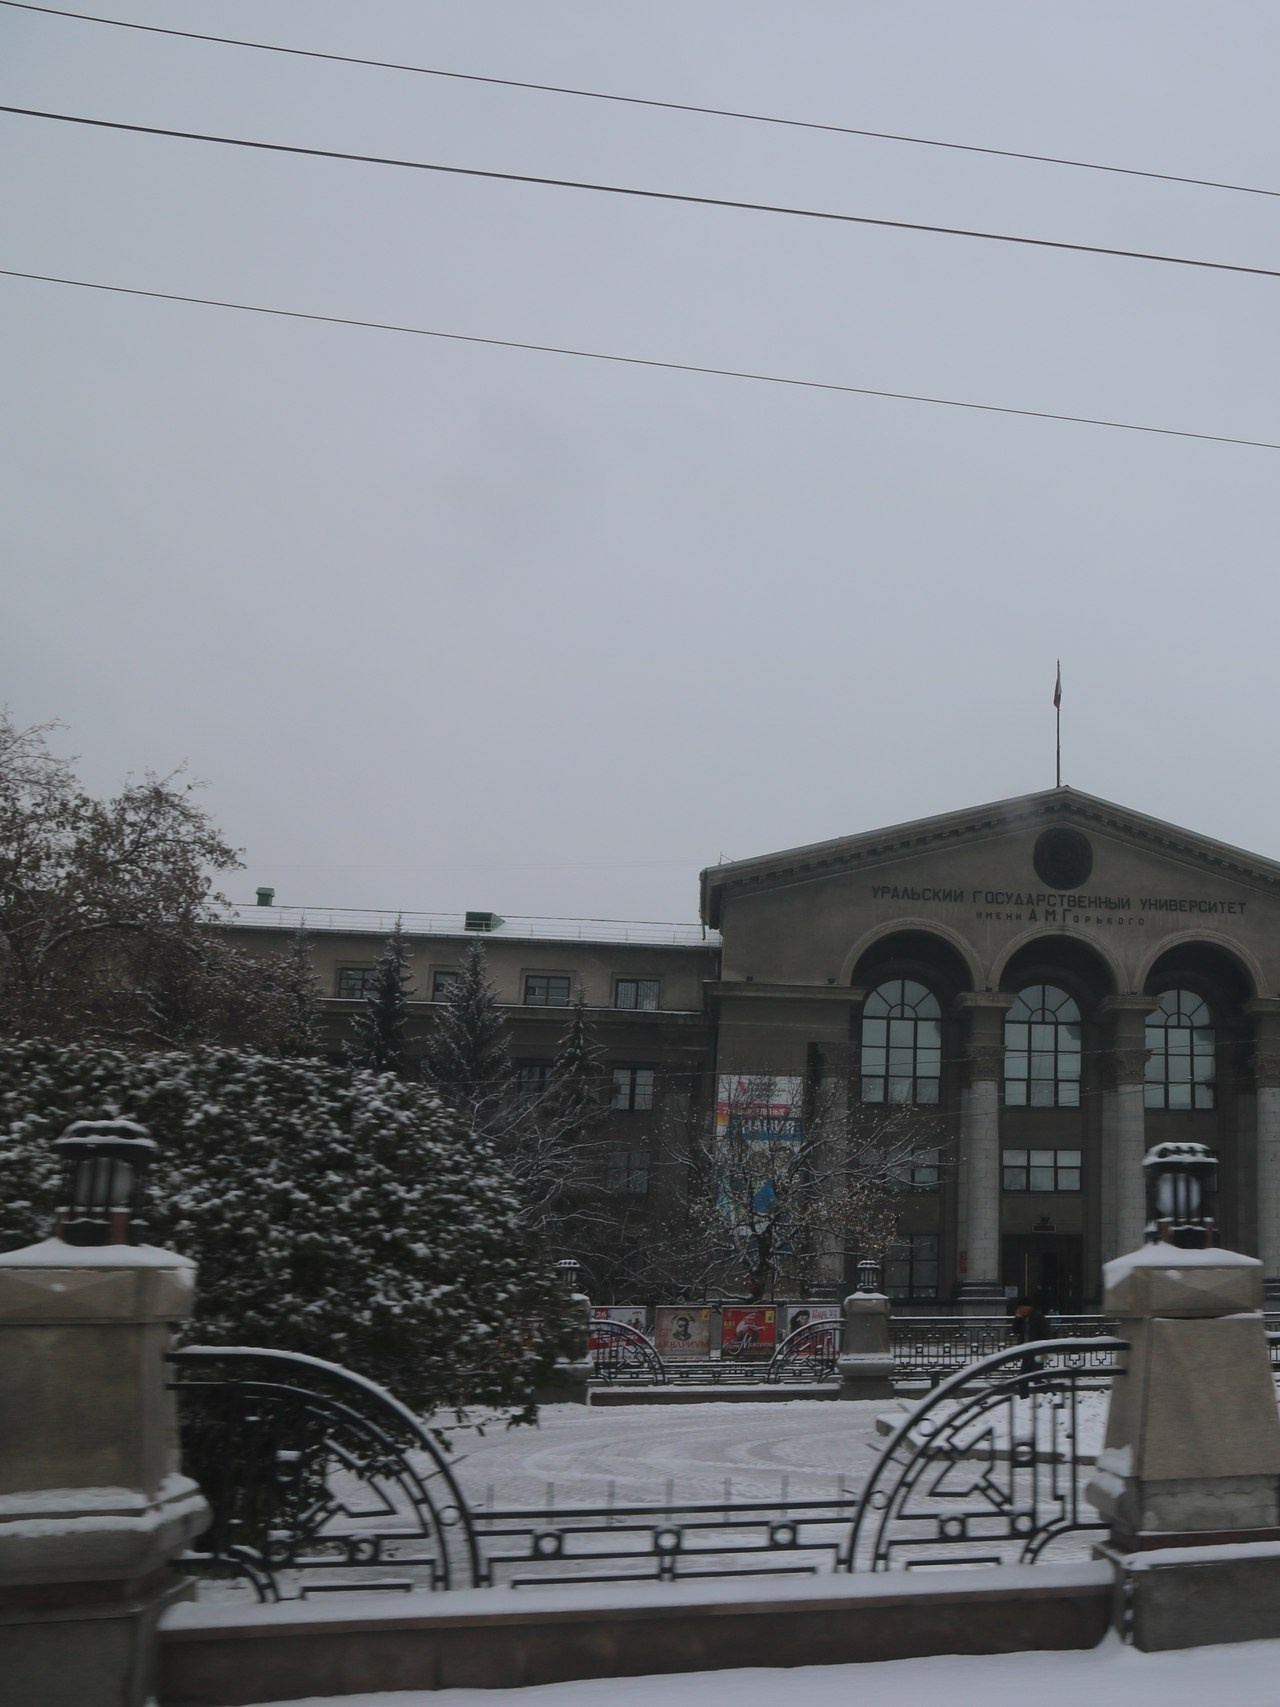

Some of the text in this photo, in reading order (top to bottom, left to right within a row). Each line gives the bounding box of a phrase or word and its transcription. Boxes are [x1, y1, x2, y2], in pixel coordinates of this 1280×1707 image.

[872, 886, 1247, 914] УРАЛЬСКИЙ ГОСУДАРСТВЕННЫЙ УНИВЕРСИТЕТ
